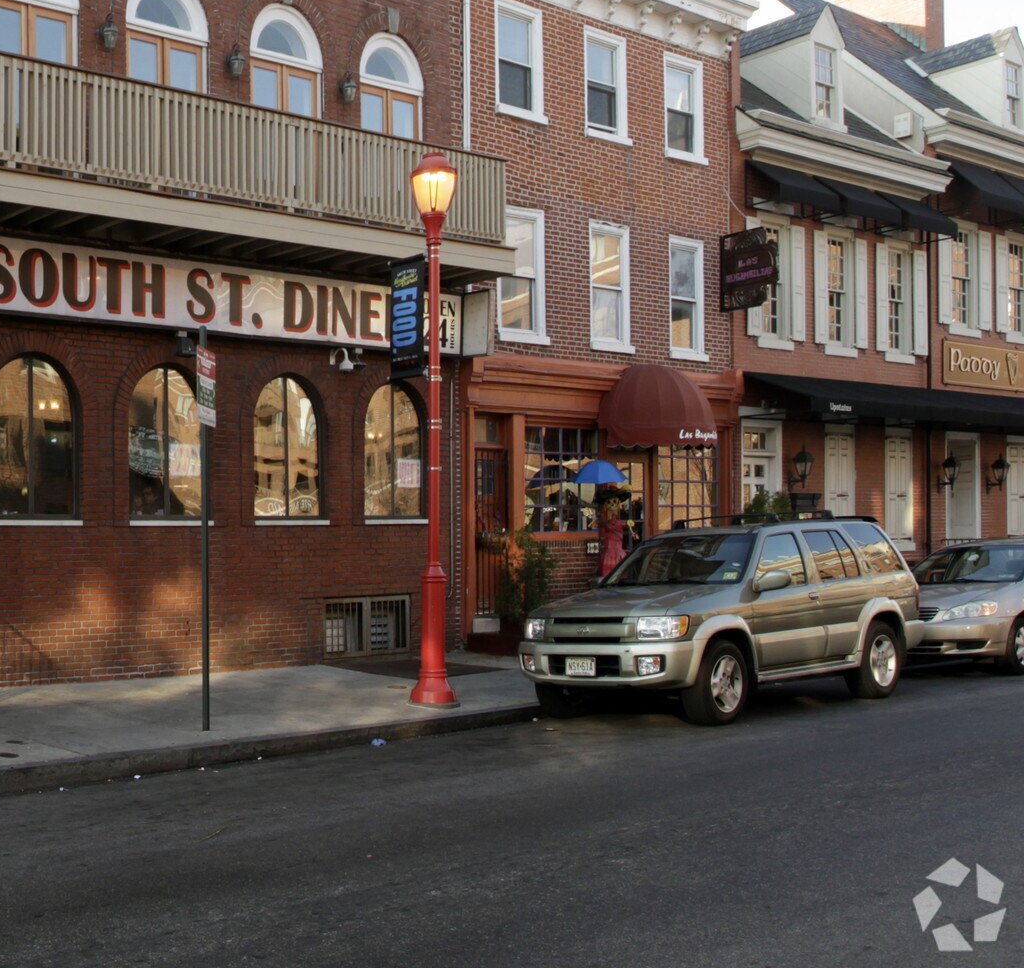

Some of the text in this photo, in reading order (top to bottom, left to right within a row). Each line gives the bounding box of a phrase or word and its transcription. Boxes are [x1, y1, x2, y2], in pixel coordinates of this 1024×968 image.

[737, 256, 759, 268] LAS
[186, 268, 263, 330] ST.
[423, 298, 455, 317] OEN
[392, 287, 418, 354] FOOD.
[949, 347, 1001, 381] Paddy
[679, 429, 693, 440] Las
